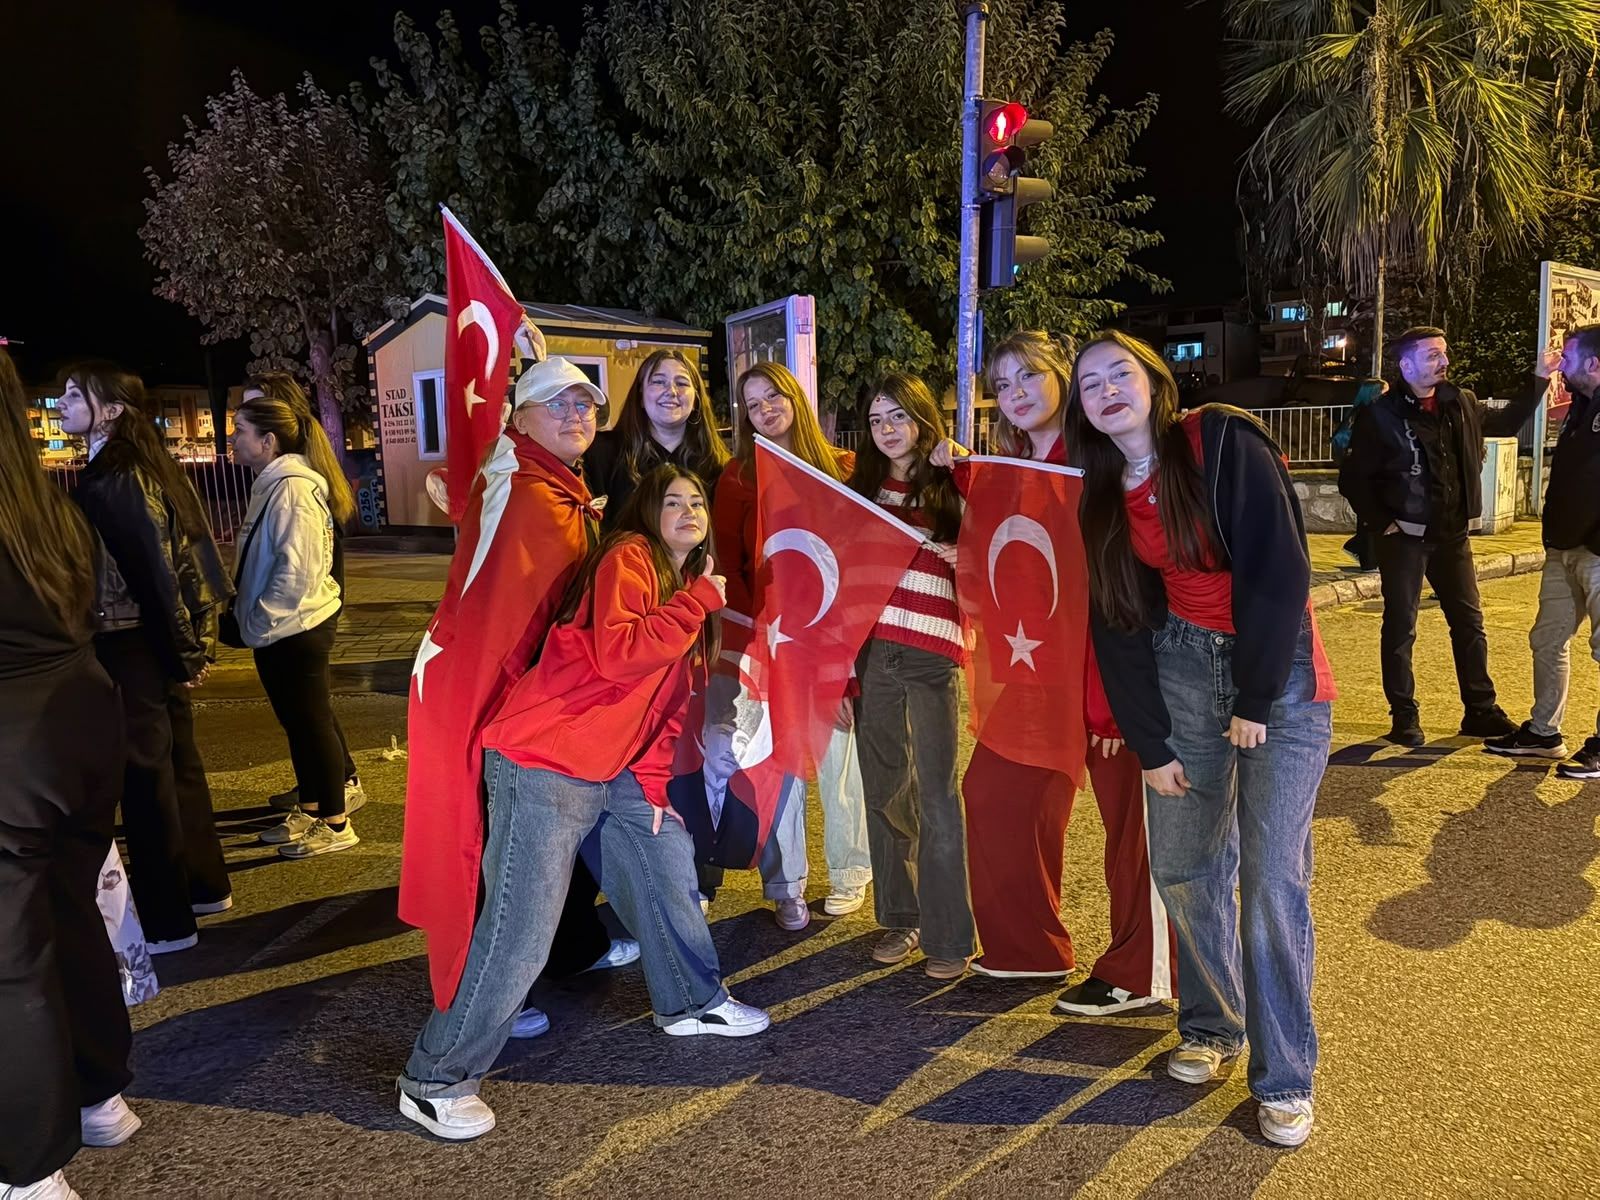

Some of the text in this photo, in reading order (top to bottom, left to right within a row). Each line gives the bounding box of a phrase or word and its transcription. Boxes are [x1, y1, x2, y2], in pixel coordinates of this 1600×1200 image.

[385, 388, 407, 401] STAD
[381, 397, 414, 418] TAKSİ
[360, 491, 373, 523] 0 256
